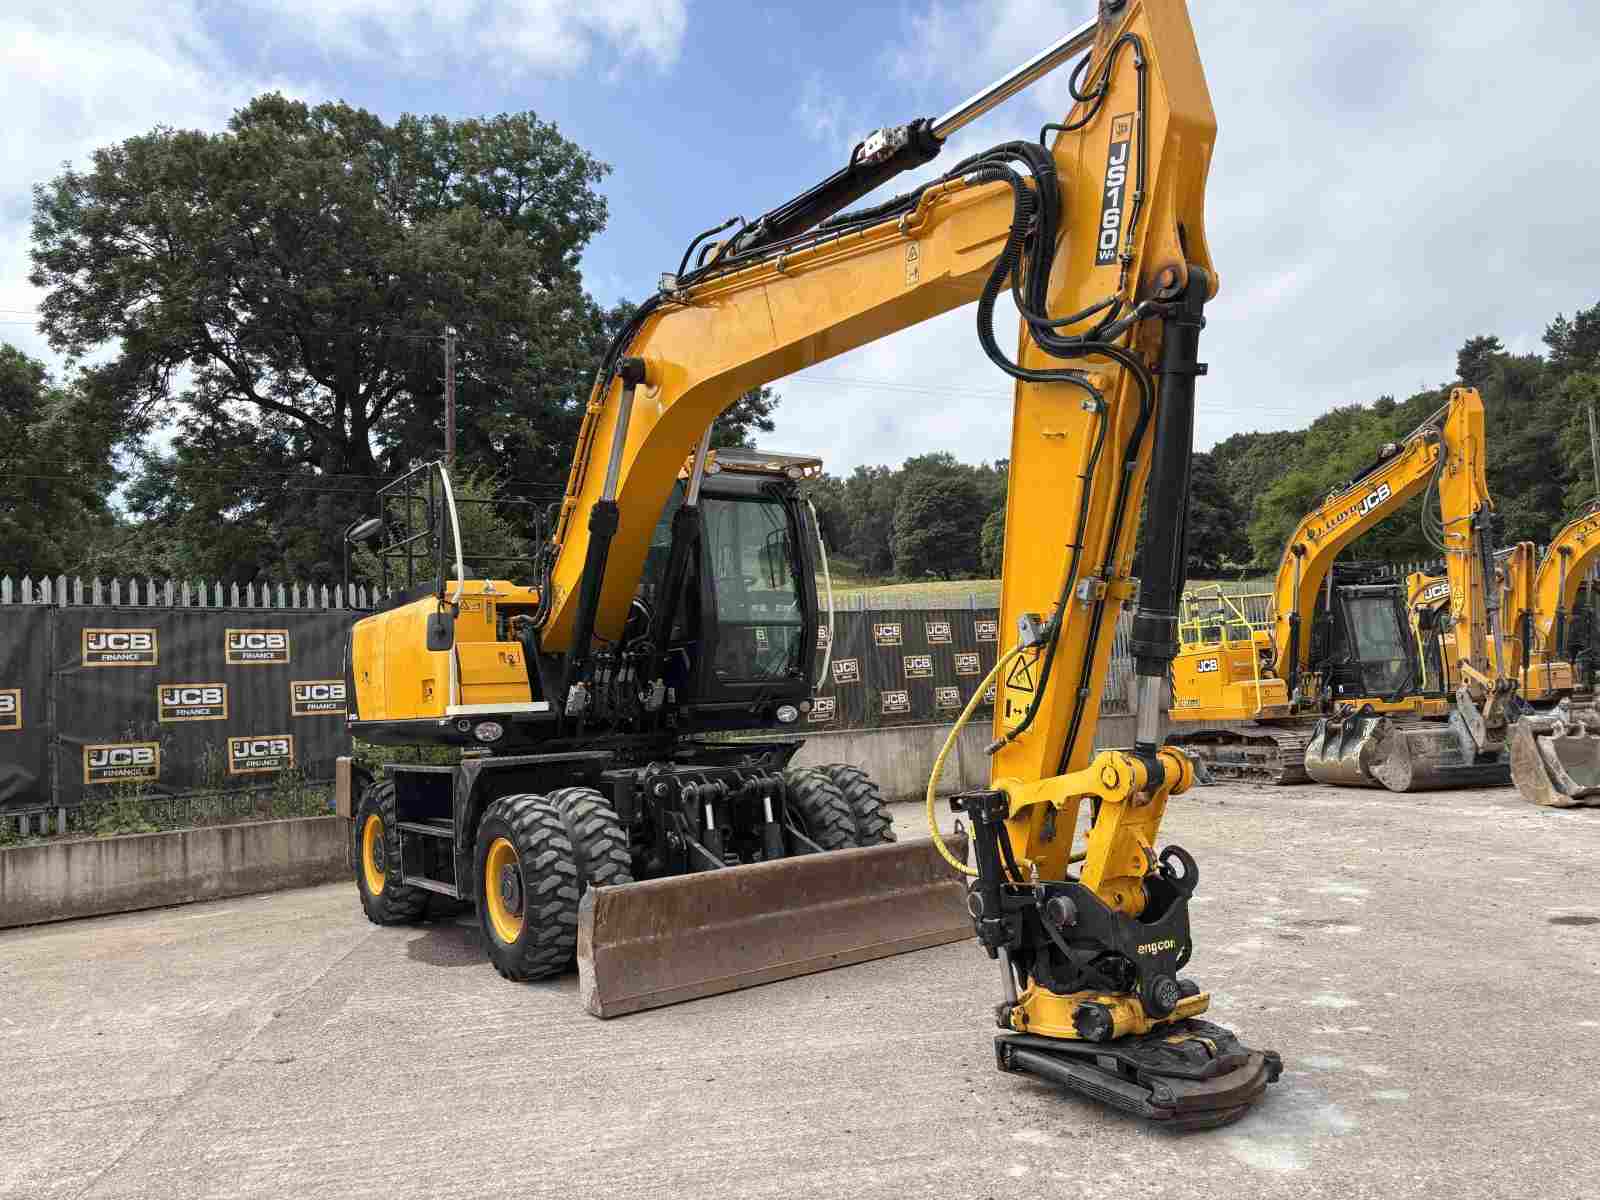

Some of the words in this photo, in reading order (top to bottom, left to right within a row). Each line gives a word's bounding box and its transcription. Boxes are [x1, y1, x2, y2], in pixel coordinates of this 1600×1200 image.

[1360, 483, 1392, 515] JCB
[1424, 583, 1449, 600] JCB
[927, 623, 949, 635] JCB
[88, 633, 152, 650] JCB
[230, 634, 285, 649] JCB
[833, 661, 856, 673] JCB
[905, 658, 930, 669] JCB
[1199, 659, 1217, 672] JCB
[163, 688, 223, 705] JCB
[295, 685, 346, 700] JCB
[883, 694, 905, 705] JCB
[811, 700, 834, 713] JCB
[233, 740, 288, 758] JCB
[89, 747, 154, 767] JCB
